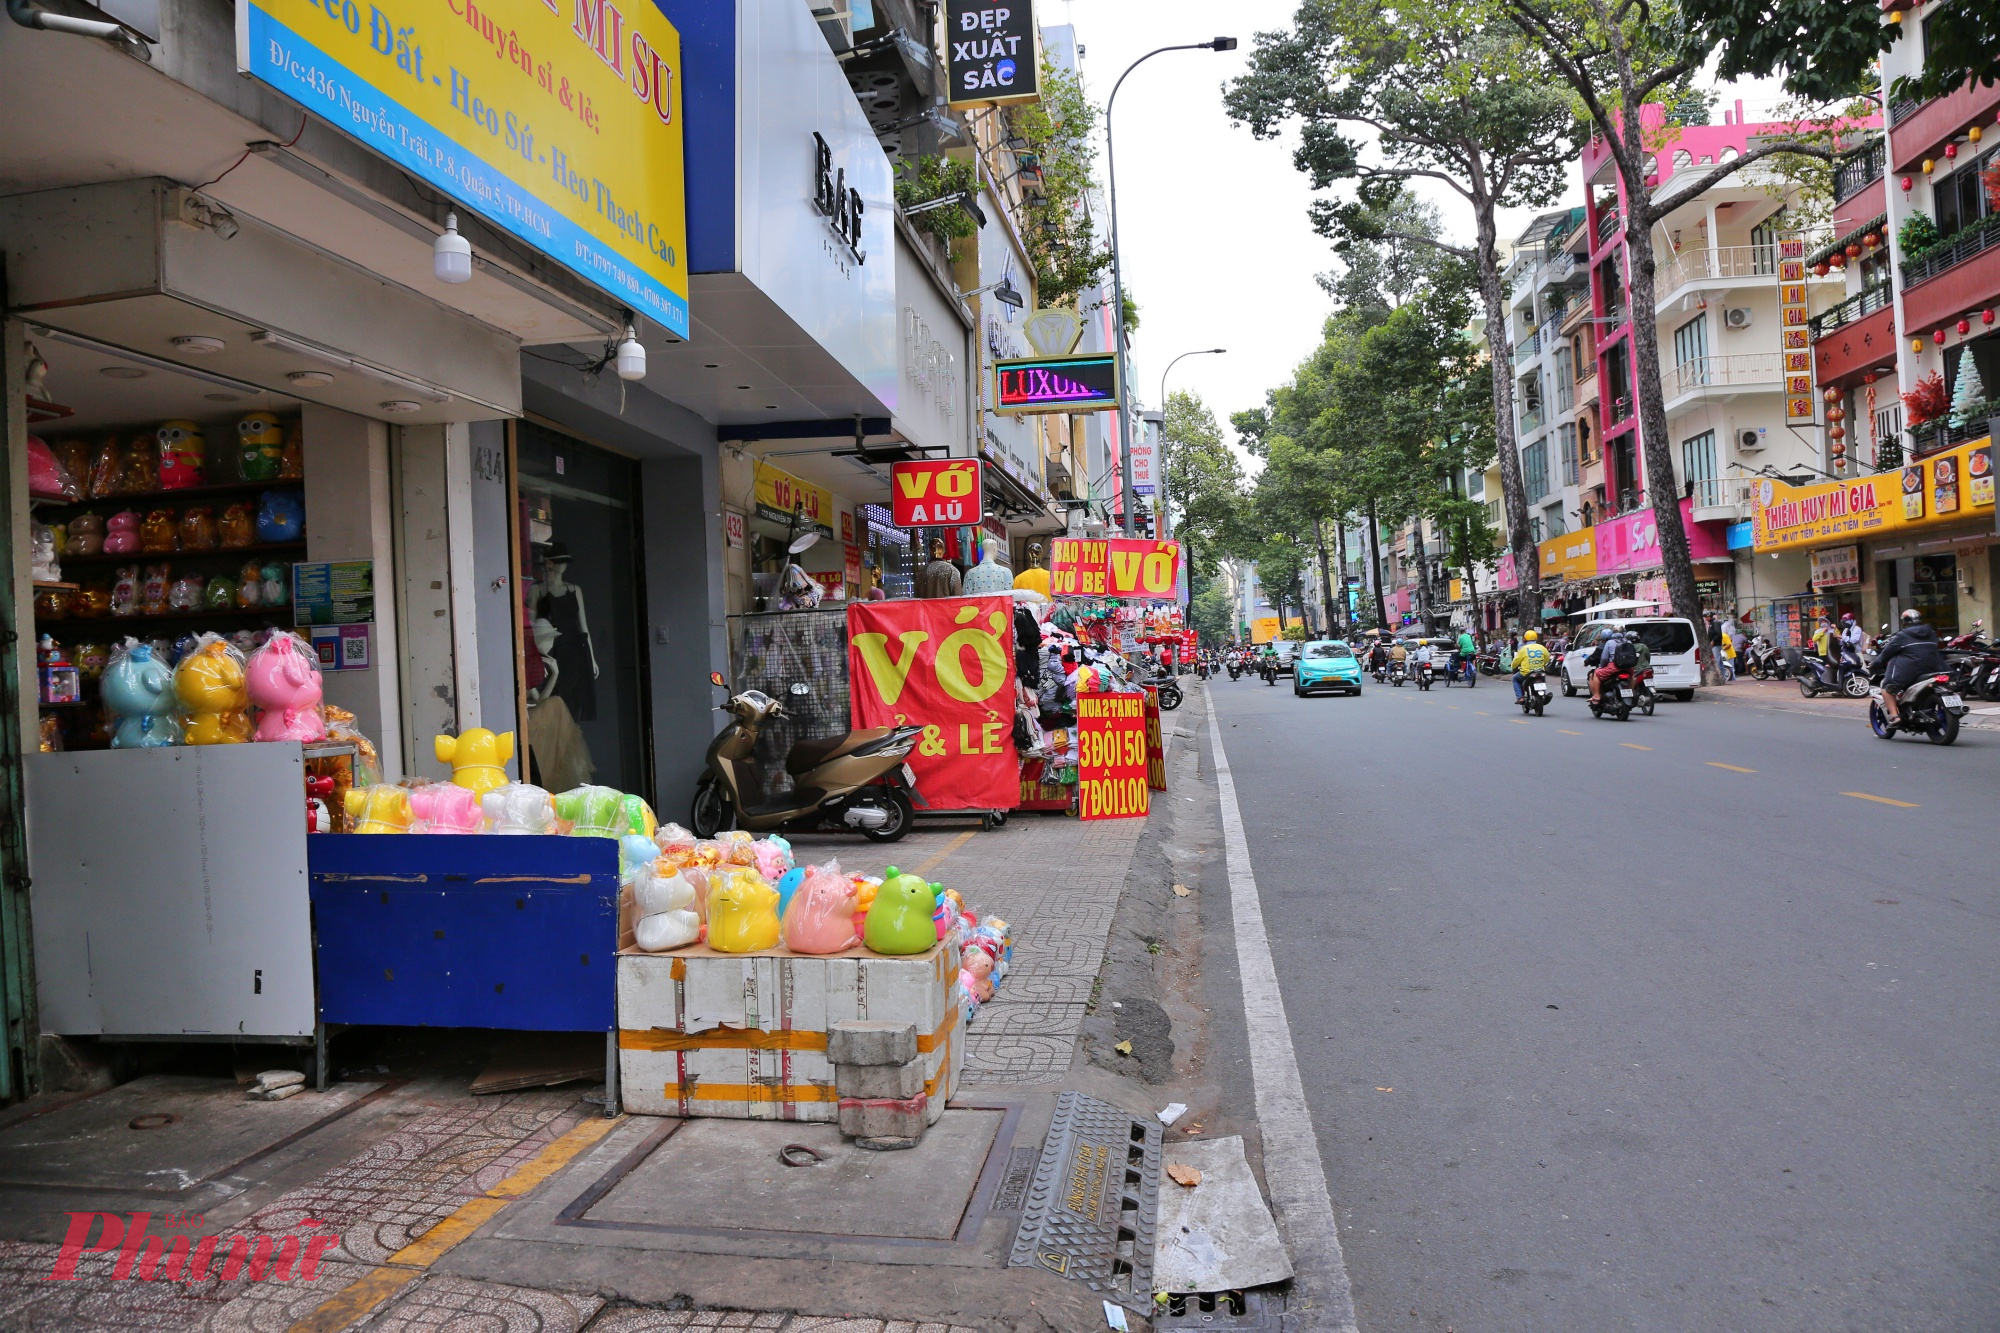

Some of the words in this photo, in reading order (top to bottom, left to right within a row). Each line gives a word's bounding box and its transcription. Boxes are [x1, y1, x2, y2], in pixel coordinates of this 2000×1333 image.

[961, 8, 1011, 34] ĐẸP
[953, 30, 1022, 62] XUẤT
[632, 30, 673, 125] SU
[963, 61, 1015, 91] SẮC
[538, 61, 553, 95] sỉ
[559, 76, 573, 112] &
[578, 91, 600, 135] lẻ:
[308, 0, 361, 34] eo
[368, 4, 425, 83] Đất
[433, 75, 441, 87] -
[449, 65, 499, 136] Heo
[505, 111, 534, 162] Sứ
[538, 155, 546, 164] -
[551, 145, 589, 202] Heo
[593, 178, 644, 245] Thạch
[648, 223, 676, 267] Cao
[269, 38, 336, 101] Đ/c:436
[339, 84, 396, 140] Nguyễn
[399, 124, 433, 167] Trãi,
[435, 146, 460, 184] P.8,
[461, 166, 492, 201] Quận
[494, 187, 505, 212] 5,
[506, 193, 551, 239] TP.HCM
[575, 240, 592, 265] ĐT:
[1784, 263, 1800, 280] HUY
[1789, 286, 1800, 303] MÌ
[1788, 309, 1803, 324] GIA
[1130, 445, 1152, 456] PHÒNG
[1134, 459, 1149, 468] CHO
[896, 463, 974, 499] VỚ
[1134, 468, 1149, 480] THUÊ
[774, 477, 791, 510] VỚ
[805, 489, 819, 519] LŨ
[911, 505, 928, 522] A
[934, 500, 963, 521] LŨ
[1801, 494, 1829, 524] HUY
[1830, 484, 1848, 518] MÌ
[1850, 483, 1877, 513] GIA
[728, 515, 742, 539] 432
[1790, 532, 1798, 544] VỊT
[1054, 541, 1078, 563] BAO
[1082, 542, 1107, 564] TAY
[1054, 565, 1077, 593] VỚ
[1082, 566, 1105, 593] BÉ
[1112, 542, 1178, 593] VỚ
[852, 606, 1008, 706] VỚ
[1527, 648, 1543, 659] be
[919, 724, 947, 757] &
[959, 710, 1003, 755] LẺ
